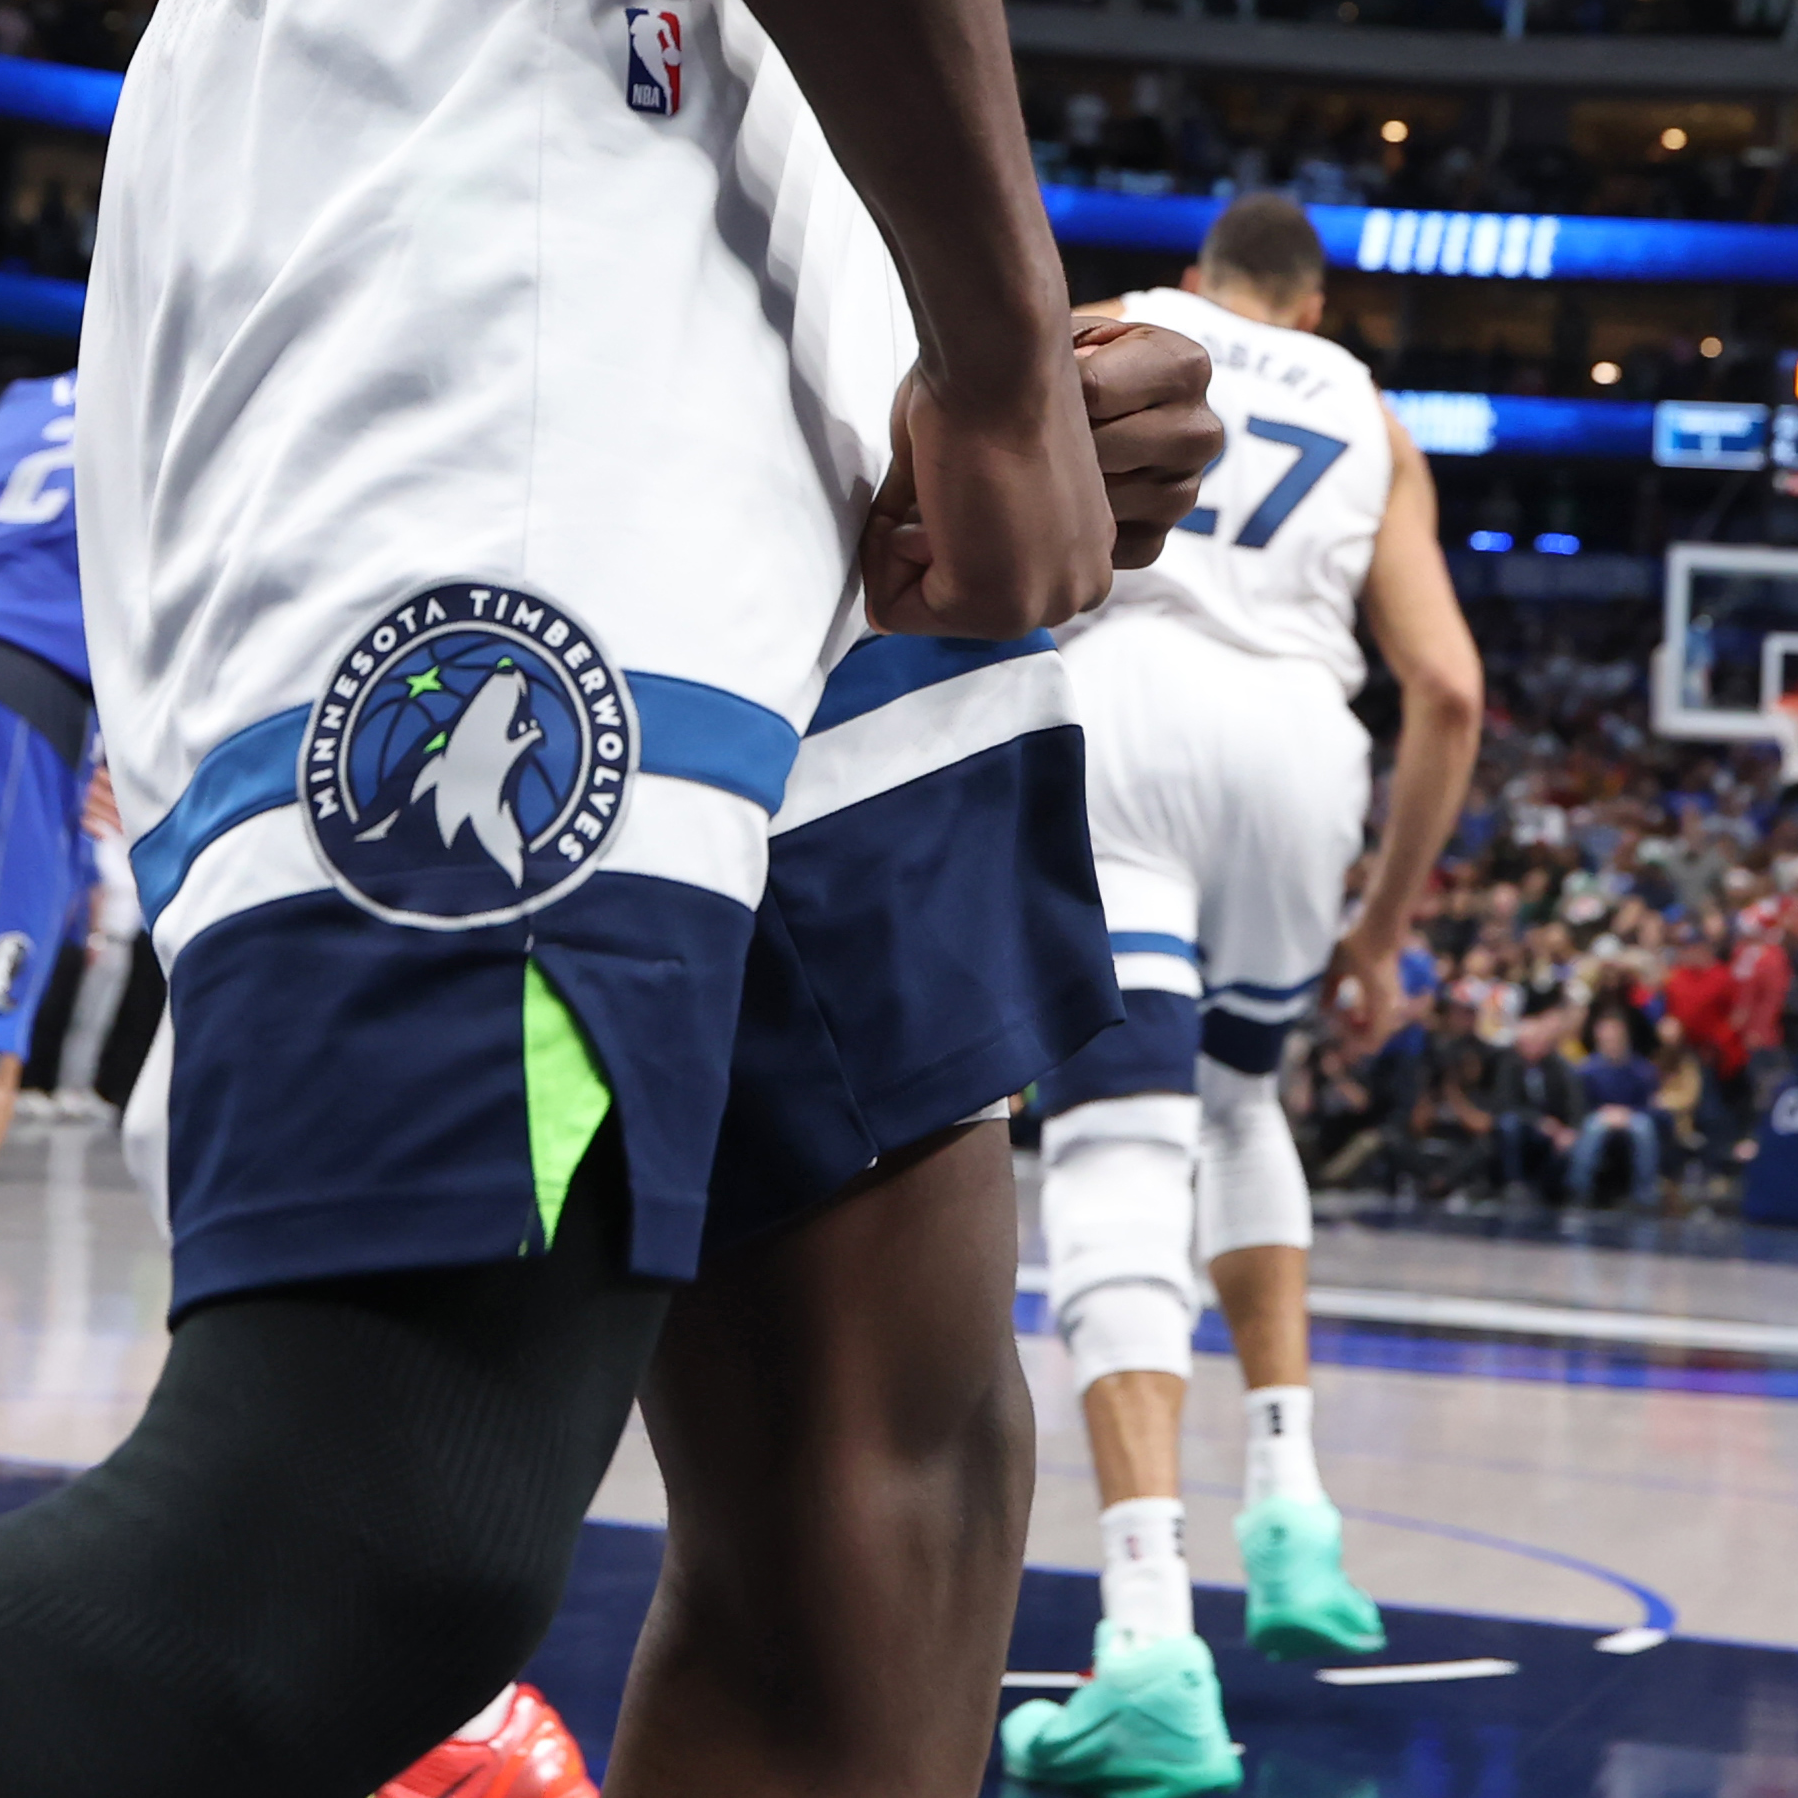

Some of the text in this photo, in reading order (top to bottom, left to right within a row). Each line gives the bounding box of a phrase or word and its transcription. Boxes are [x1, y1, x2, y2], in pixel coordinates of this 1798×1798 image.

[633, 83, 660, 107] NBA
[1201, 333, 1335, 400] OBERT
[314, 588, 627, 863] MINNESOTA TIMBERWOLVES
